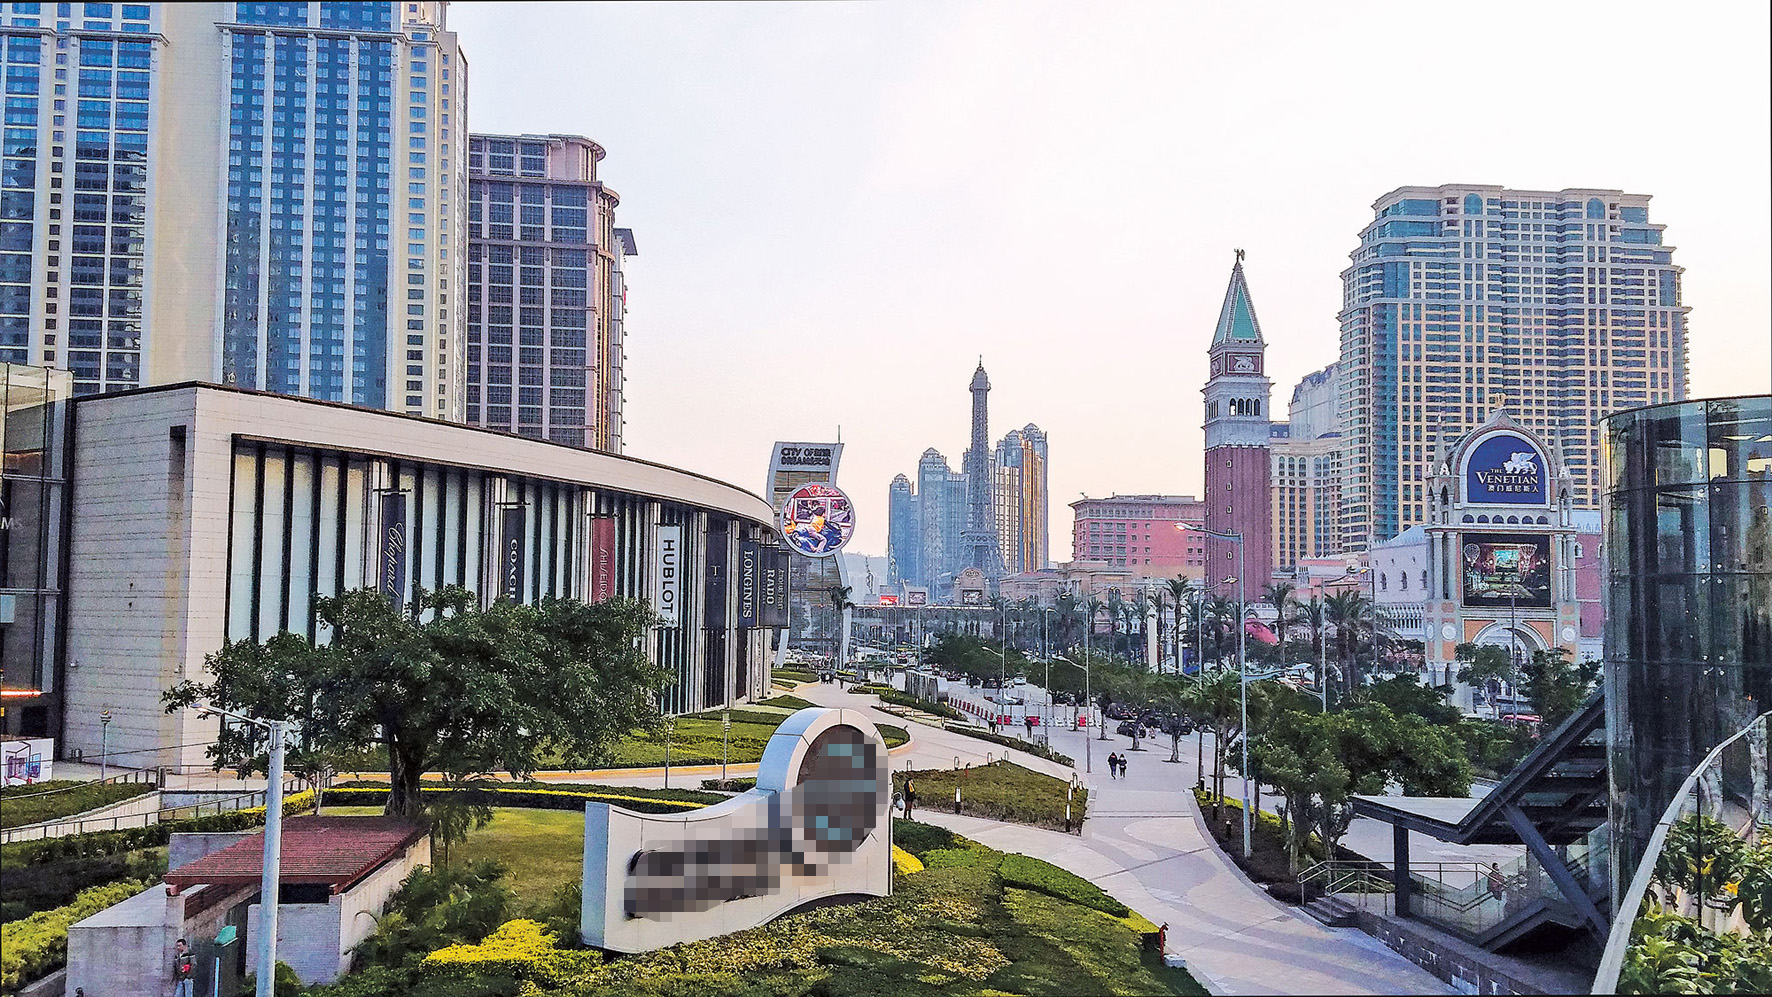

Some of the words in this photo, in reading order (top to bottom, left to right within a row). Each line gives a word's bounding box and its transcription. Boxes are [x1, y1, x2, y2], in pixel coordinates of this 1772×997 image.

[1475, 471, 1538, 484] VENETIAN
[384, 522, 404, 598] Chopard
[509, 539, 518, 599] COACH
[599, 547, 609, 601] SHISEIDO
[661, 539, 675, 614] HUBLOT
[742, 550, 754, 618] LONGINES
[766, 569, 776, 605] RADO
